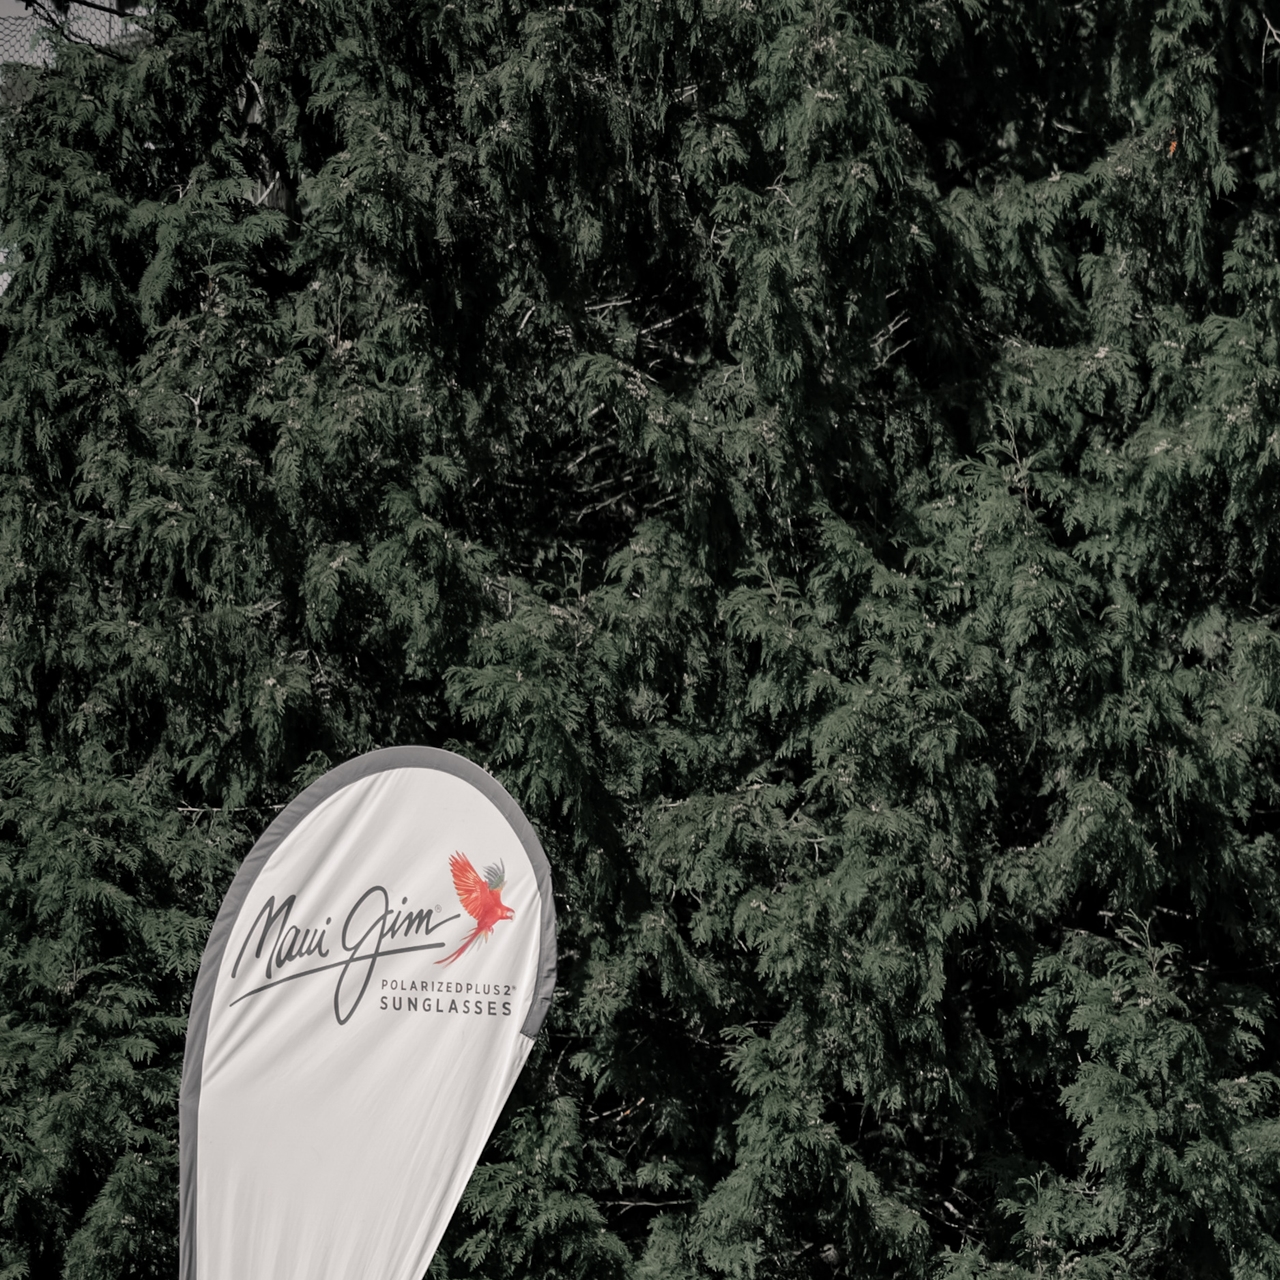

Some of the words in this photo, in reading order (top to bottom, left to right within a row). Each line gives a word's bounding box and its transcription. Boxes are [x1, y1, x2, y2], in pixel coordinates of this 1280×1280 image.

[231, 894, 329, 979] Maui
[334, 885, 461, 1026] Jim
[379, 996, 512, 1016] SUNGLASSES
